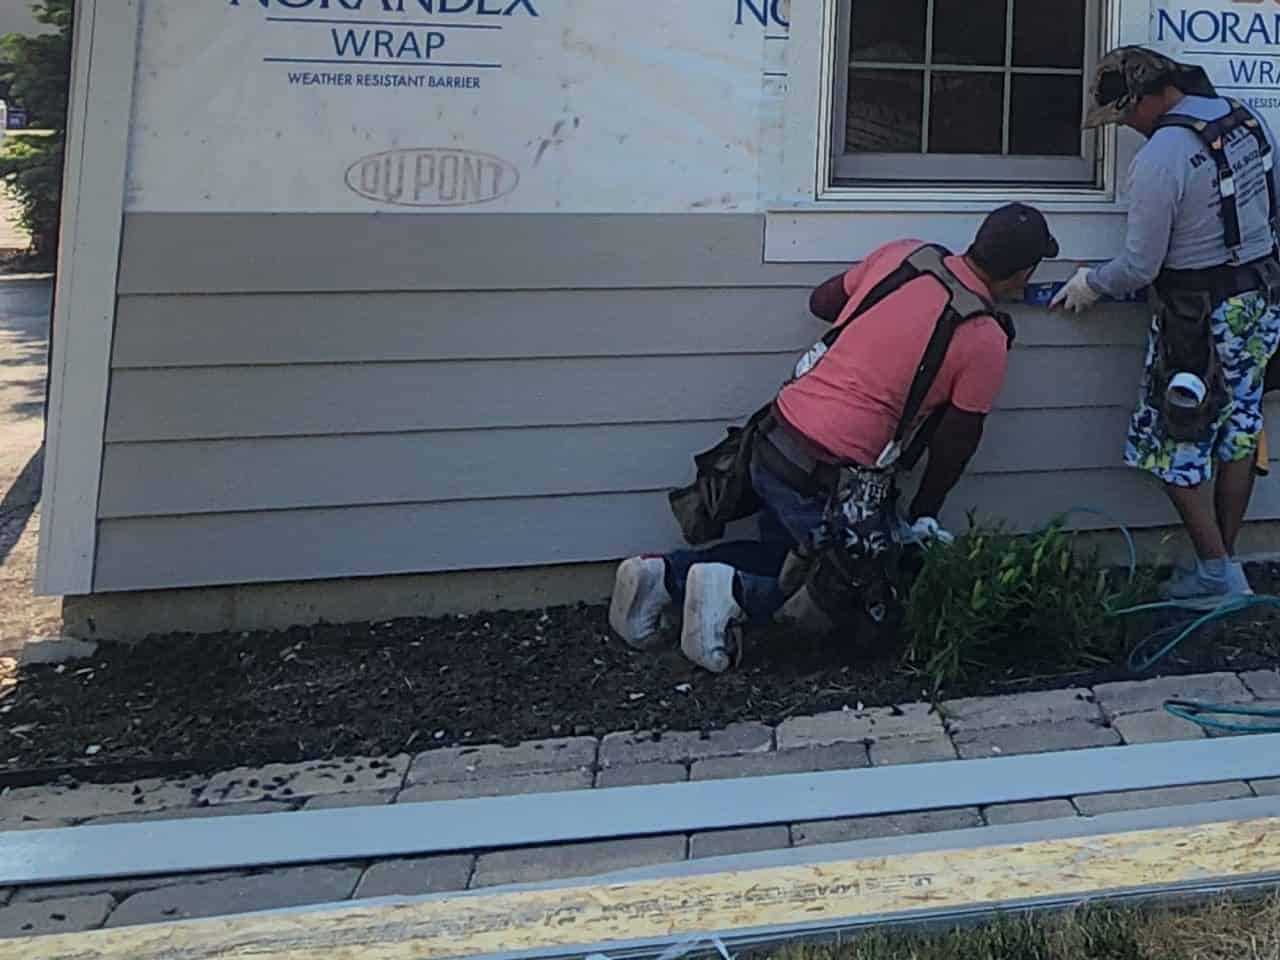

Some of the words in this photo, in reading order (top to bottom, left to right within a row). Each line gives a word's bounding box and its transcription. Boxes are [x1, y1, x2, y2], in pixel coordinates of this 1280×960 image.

[331, 28, 446, 60] WRAP
[287, 72, 352, 86] WEATHER
[356, 73, 425, 89] RESISTANT
[428, 75, 480, 89] BARRIER
